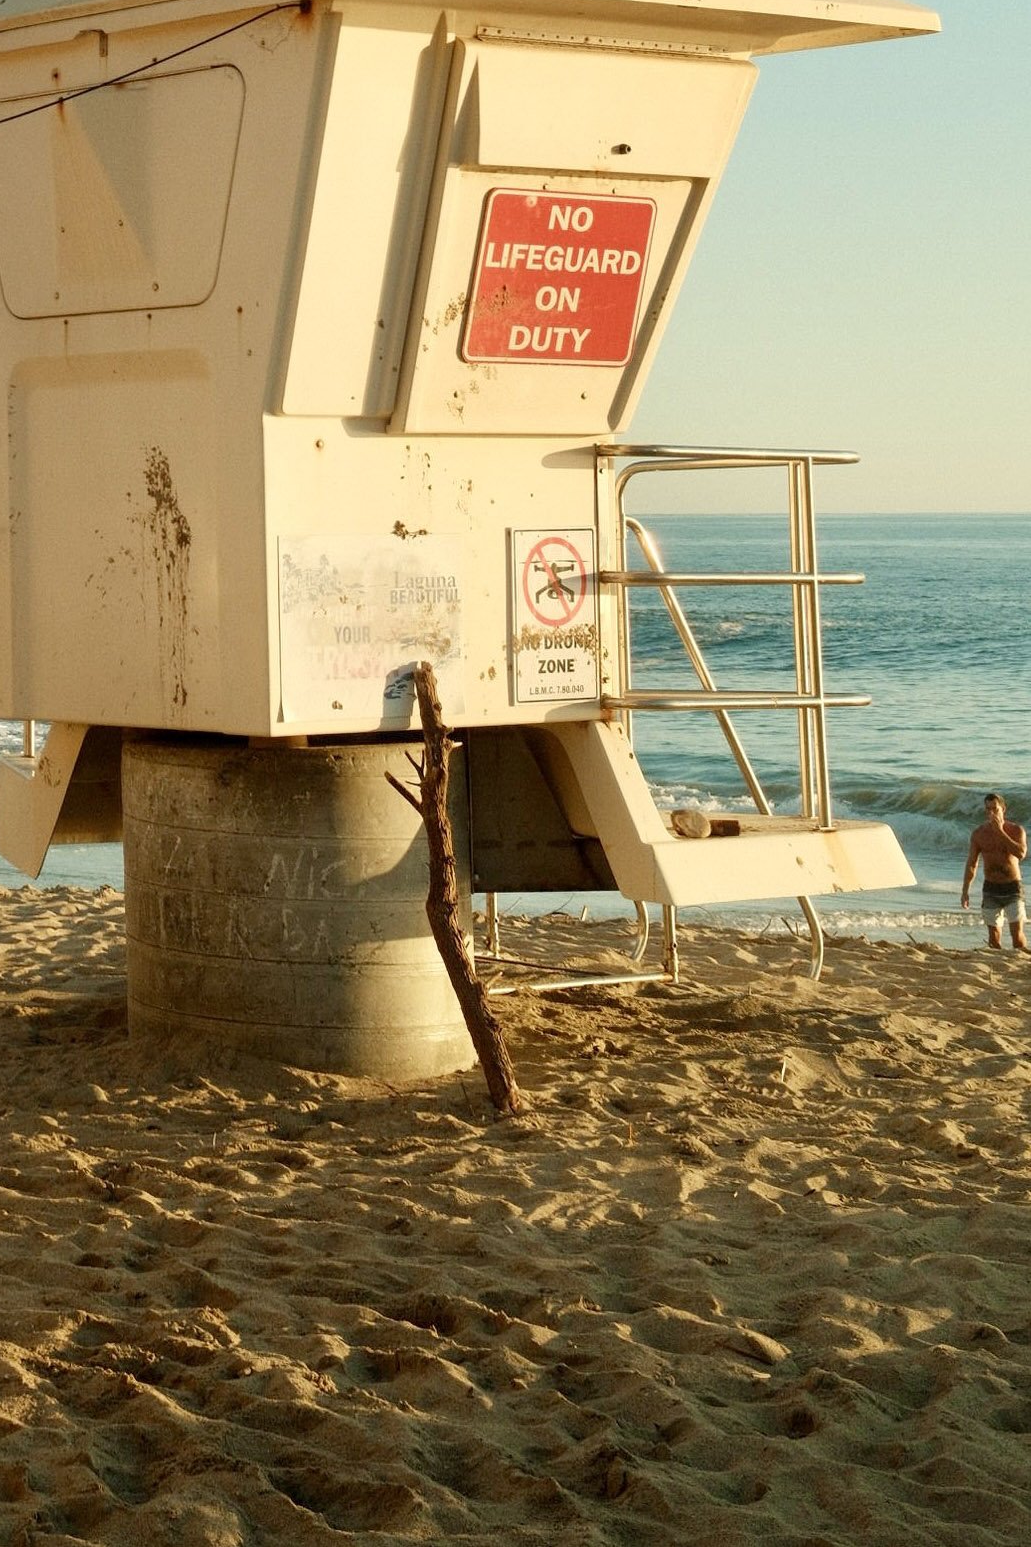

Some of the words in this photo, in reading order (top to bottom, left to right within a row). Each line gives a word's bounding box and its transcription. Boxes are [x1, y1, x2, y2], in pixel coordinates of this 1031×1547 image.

[548, 205, 594, 232] NO
[485, 242, 641, 275] LIFEGUARD
[535, 286, 581, 313] ON
[508, 325, 591, 353] DUTY
[392, 571, 456, 589] Laguna
[390, 588, 461, 605] BEAUTIFUL
[334, 626, 371, 644] YOUR
[537, 658, 576, 674] ZONE
